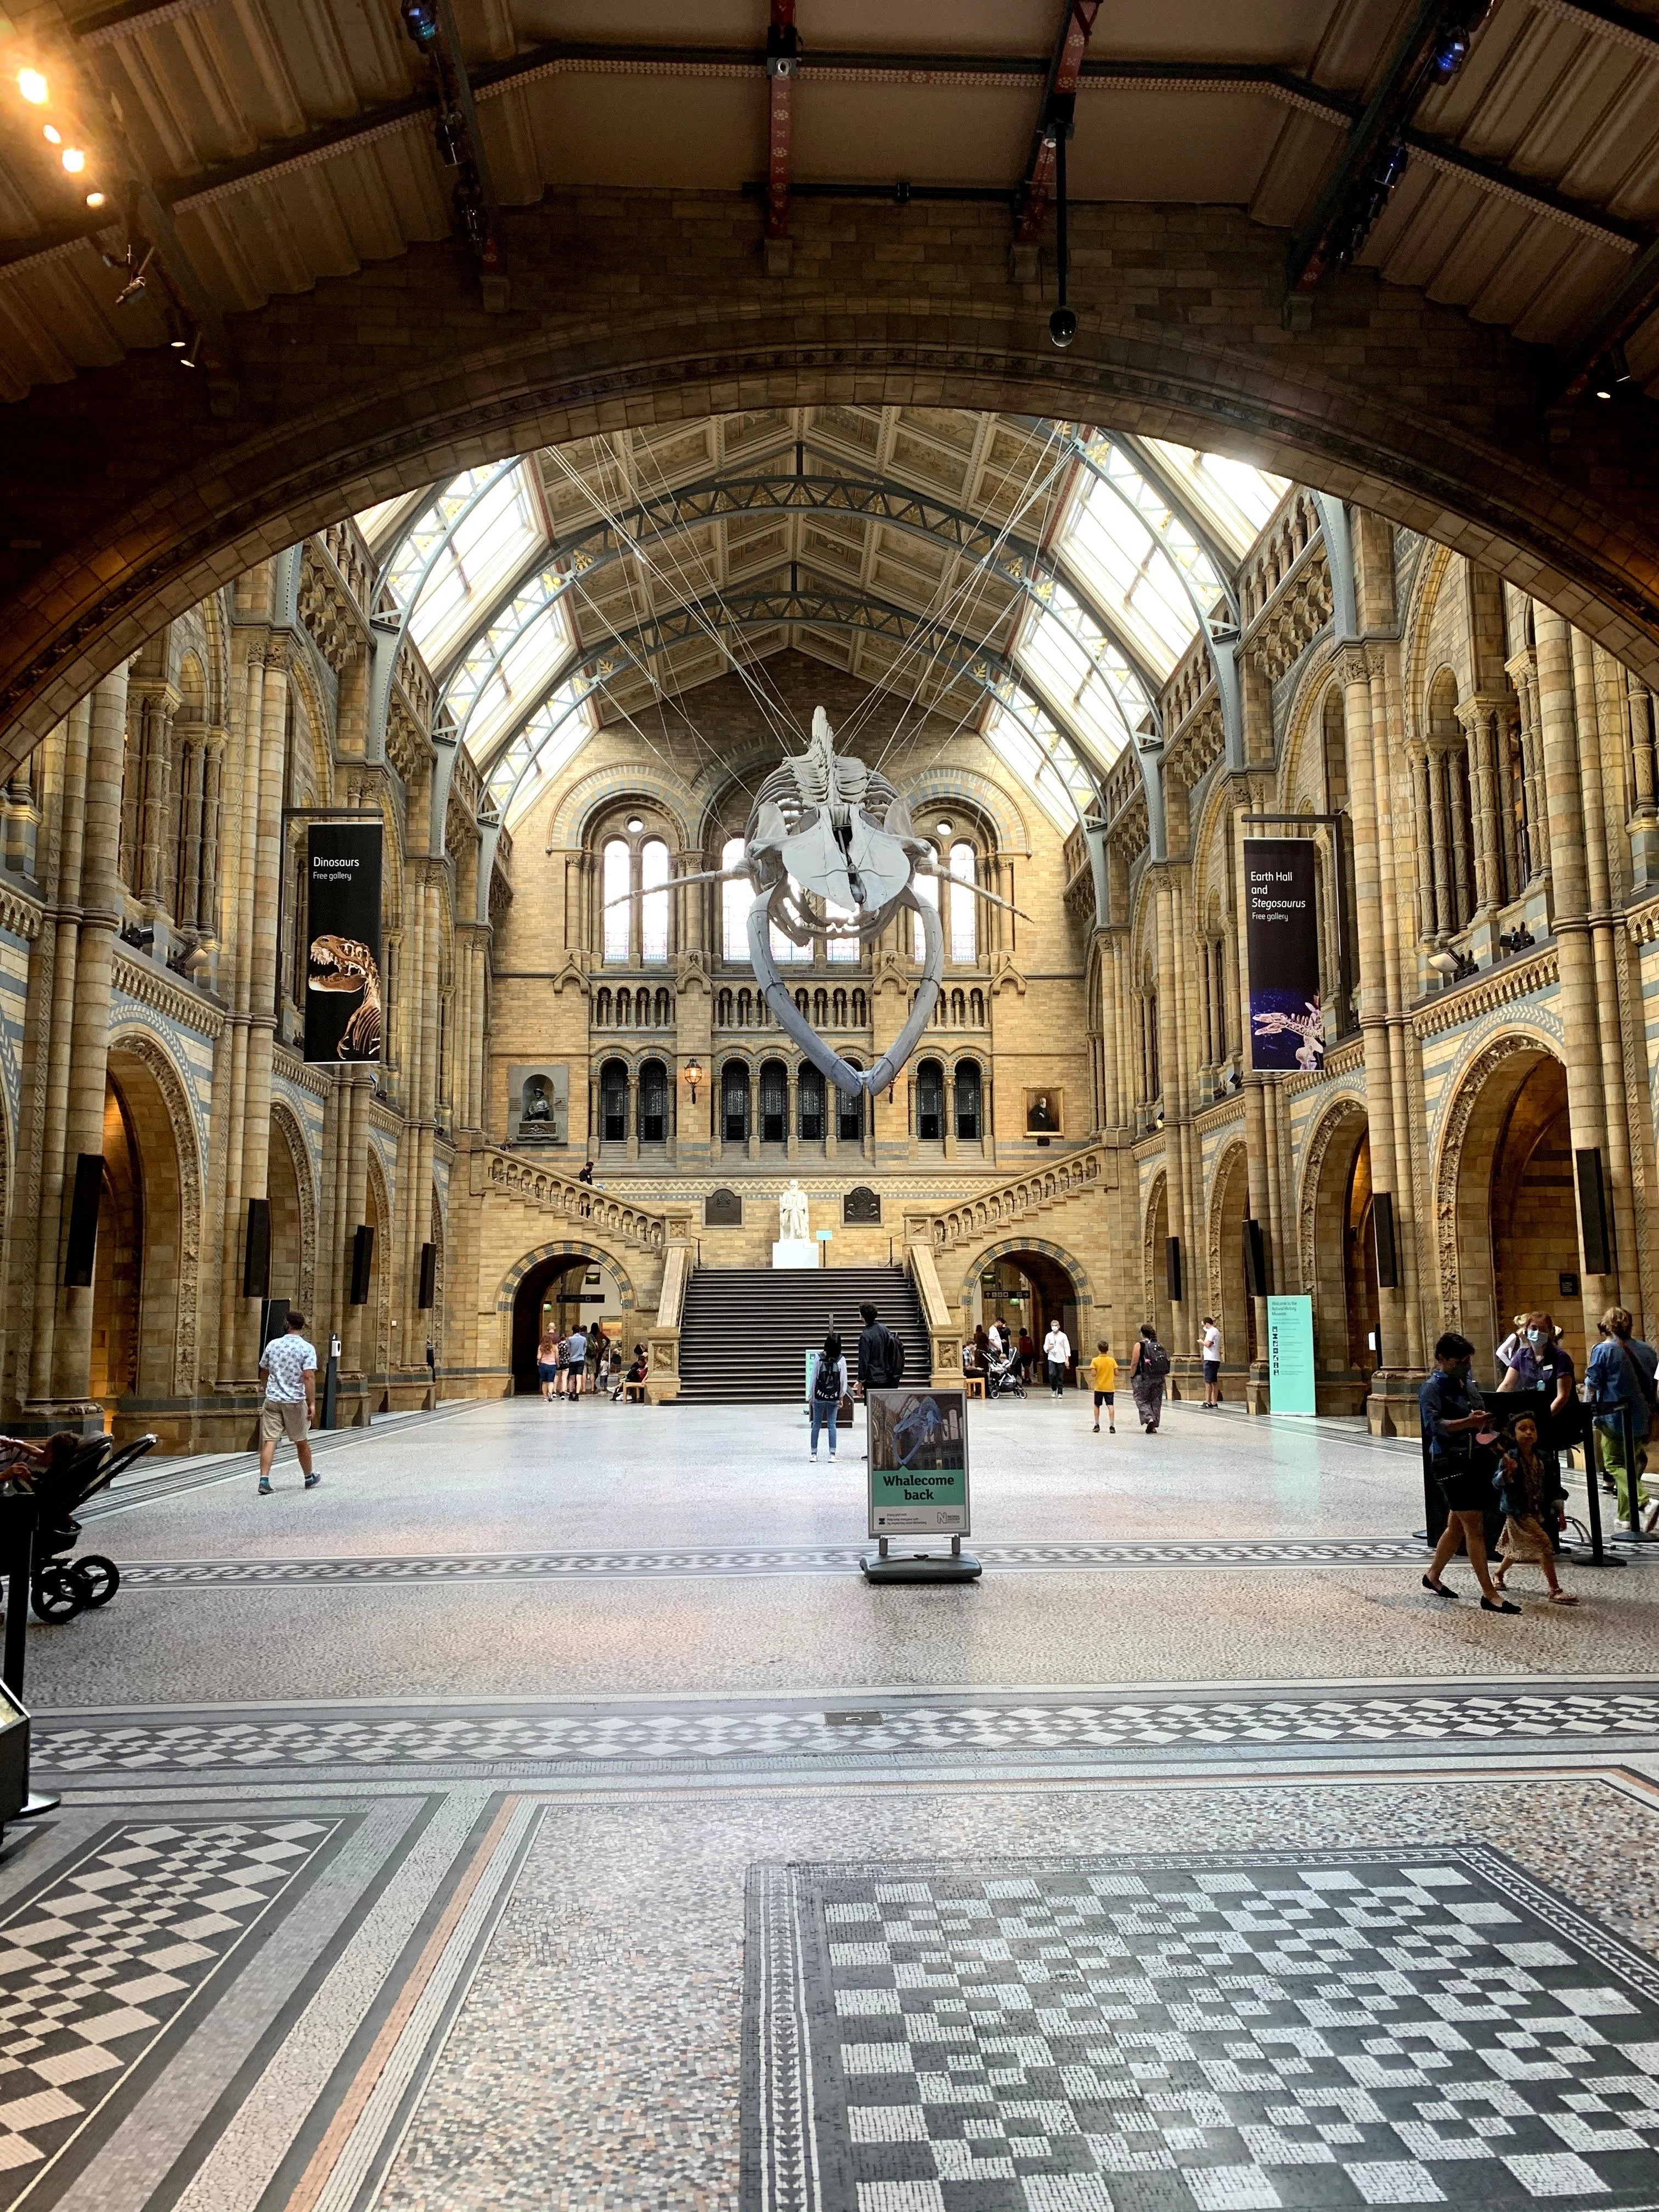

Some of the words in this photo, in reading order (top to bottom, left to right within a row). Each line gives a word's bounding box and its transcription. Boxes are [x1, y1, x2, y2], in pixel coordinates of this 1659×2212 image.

[313, 856, 360, 867] Dinosaurs
[313, 871, 328, 879] Free
[329, 871, 352, 882] gallery
[1251, 871, 1274, 881] Earth
[1276, 871, 1293, 881] Hall
[1251, 884, 1268, 894] and
[1251, 898, 1306, 910] Stegosaurus
[1267, 912, 1288, 922] gallery
[816, 1389, 838, 1399] NICCE
[883, 1475, 955, 1486] Whalecome
[904, 1489, 934, 1500] back
[937, 1512, 947, 1524] N
